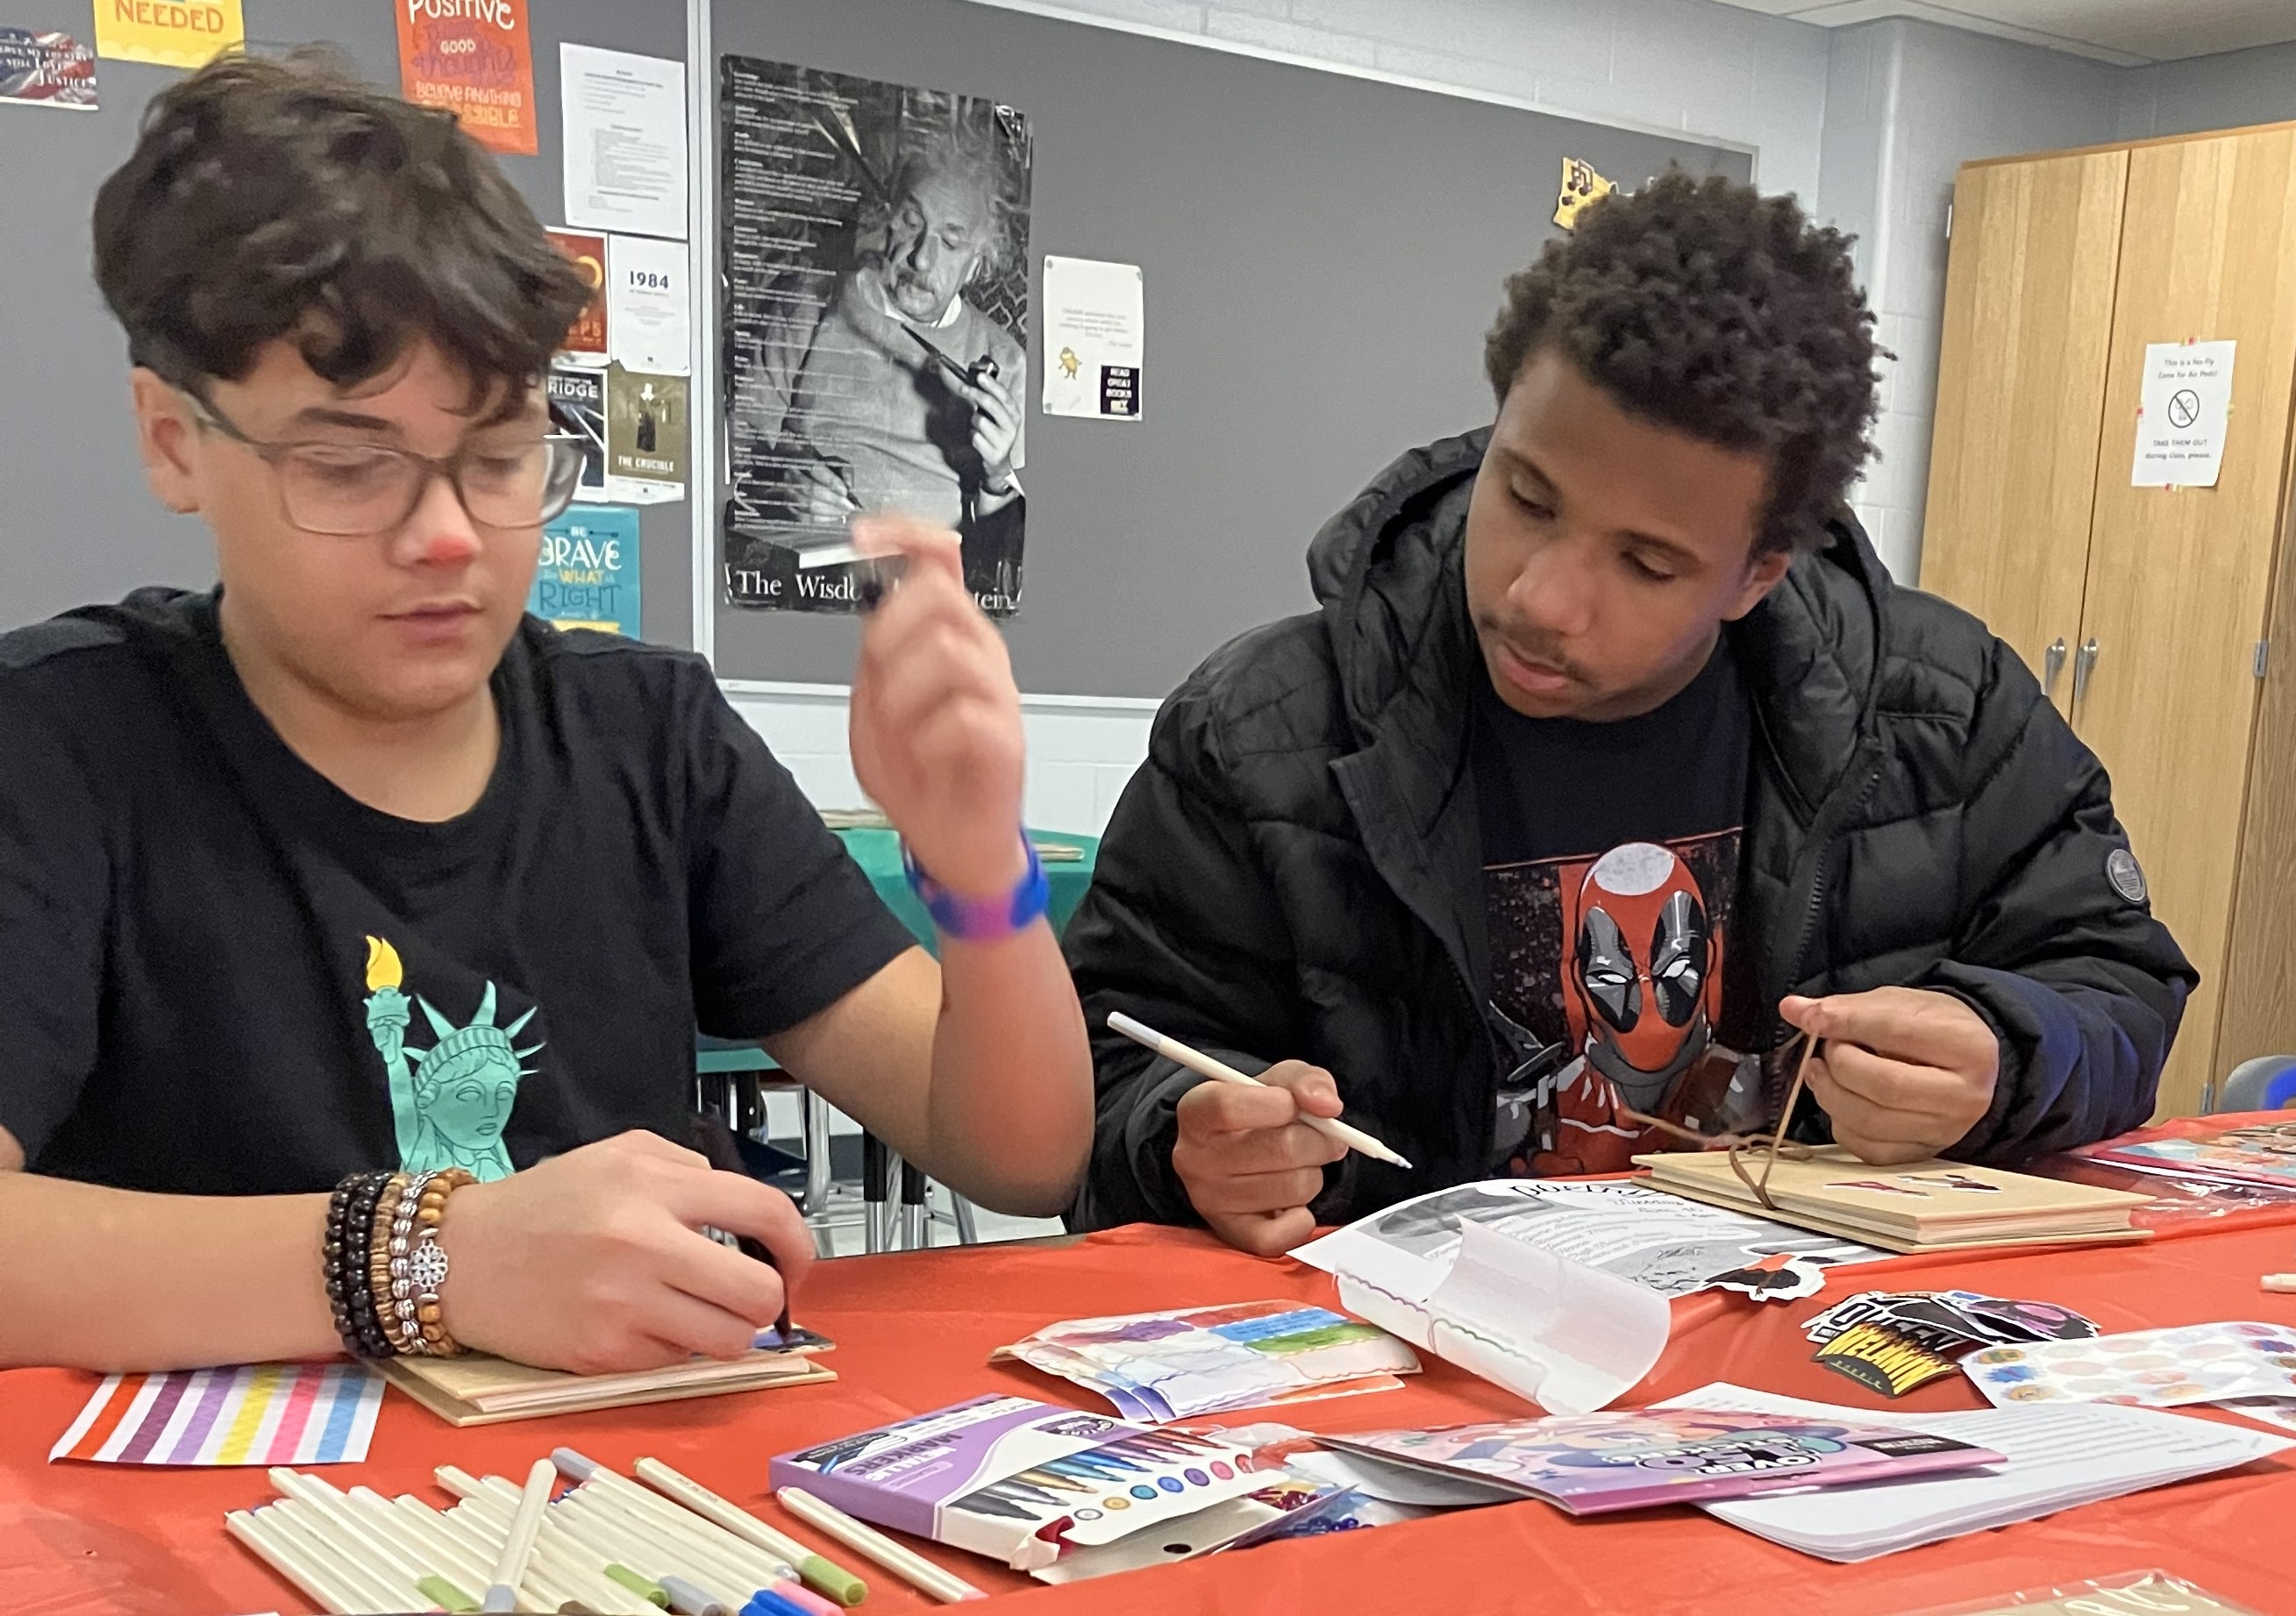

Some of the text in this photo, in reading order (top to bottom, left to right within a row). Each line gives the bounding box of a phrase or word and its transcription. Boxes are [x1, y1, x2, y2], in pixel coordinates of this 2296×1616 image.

[115, 0, 225, 33] NEEDED
[440, 39, 475, 54] GOOD
[630, 270, 669, 289] 1984
[547, 381, 598, 399] RIDGE
[617, 455, 632, 467] THE
[636, 458, 674, 473] CRUCIBLE
[571, 526, 587, 537] BE
[538, 536, 622, 571] BRAVE
[560, 568, 604, 586] WHAT
[737, 571, 782, 596] The
[538, 580, 622, 613] RIGHT
[843, 1433, 965, 1477] MARKERS
[1601, 1435, 1803, 1464] STICKERS
[1642, 1442, 1807, 1470] 150
[1698, 1455, 1813, 1474] OVER
